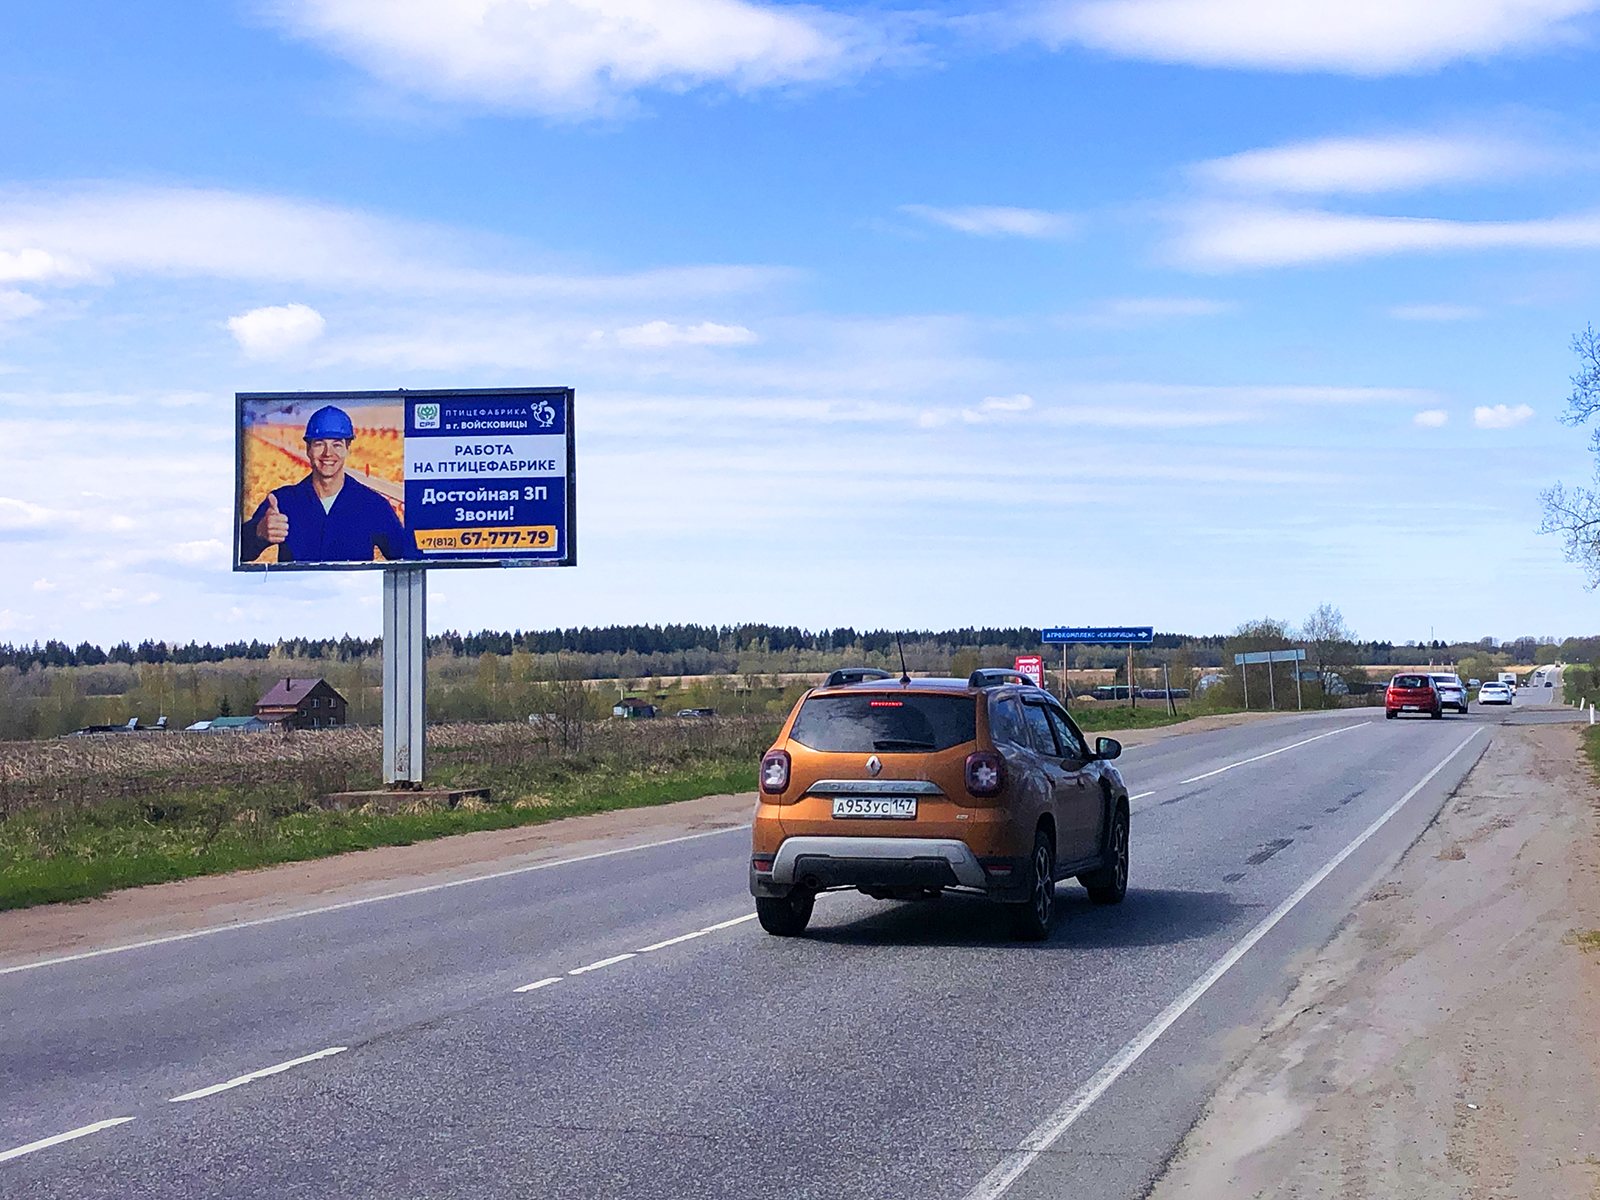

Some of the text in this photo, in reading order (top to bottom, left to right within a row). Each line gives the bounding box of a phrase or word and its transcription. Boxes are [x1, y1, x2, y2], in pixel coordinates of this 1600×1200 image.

[445, 408, 527, 417] ПТИЦЕФАБРИКА
[461, 419, 528, 430] ВОЙСКОВИЦЫ
[455, 444, 514, 456] РАБОТА
[414, 459, 556, 474] НА ПТИЦЕФАБРИКЕ
[422, 486, 547, 505] Достойная ЗП
[455, 505, 514, 522] Звони!
[420, 530, 549, 547] +7(812) 67-777-79
